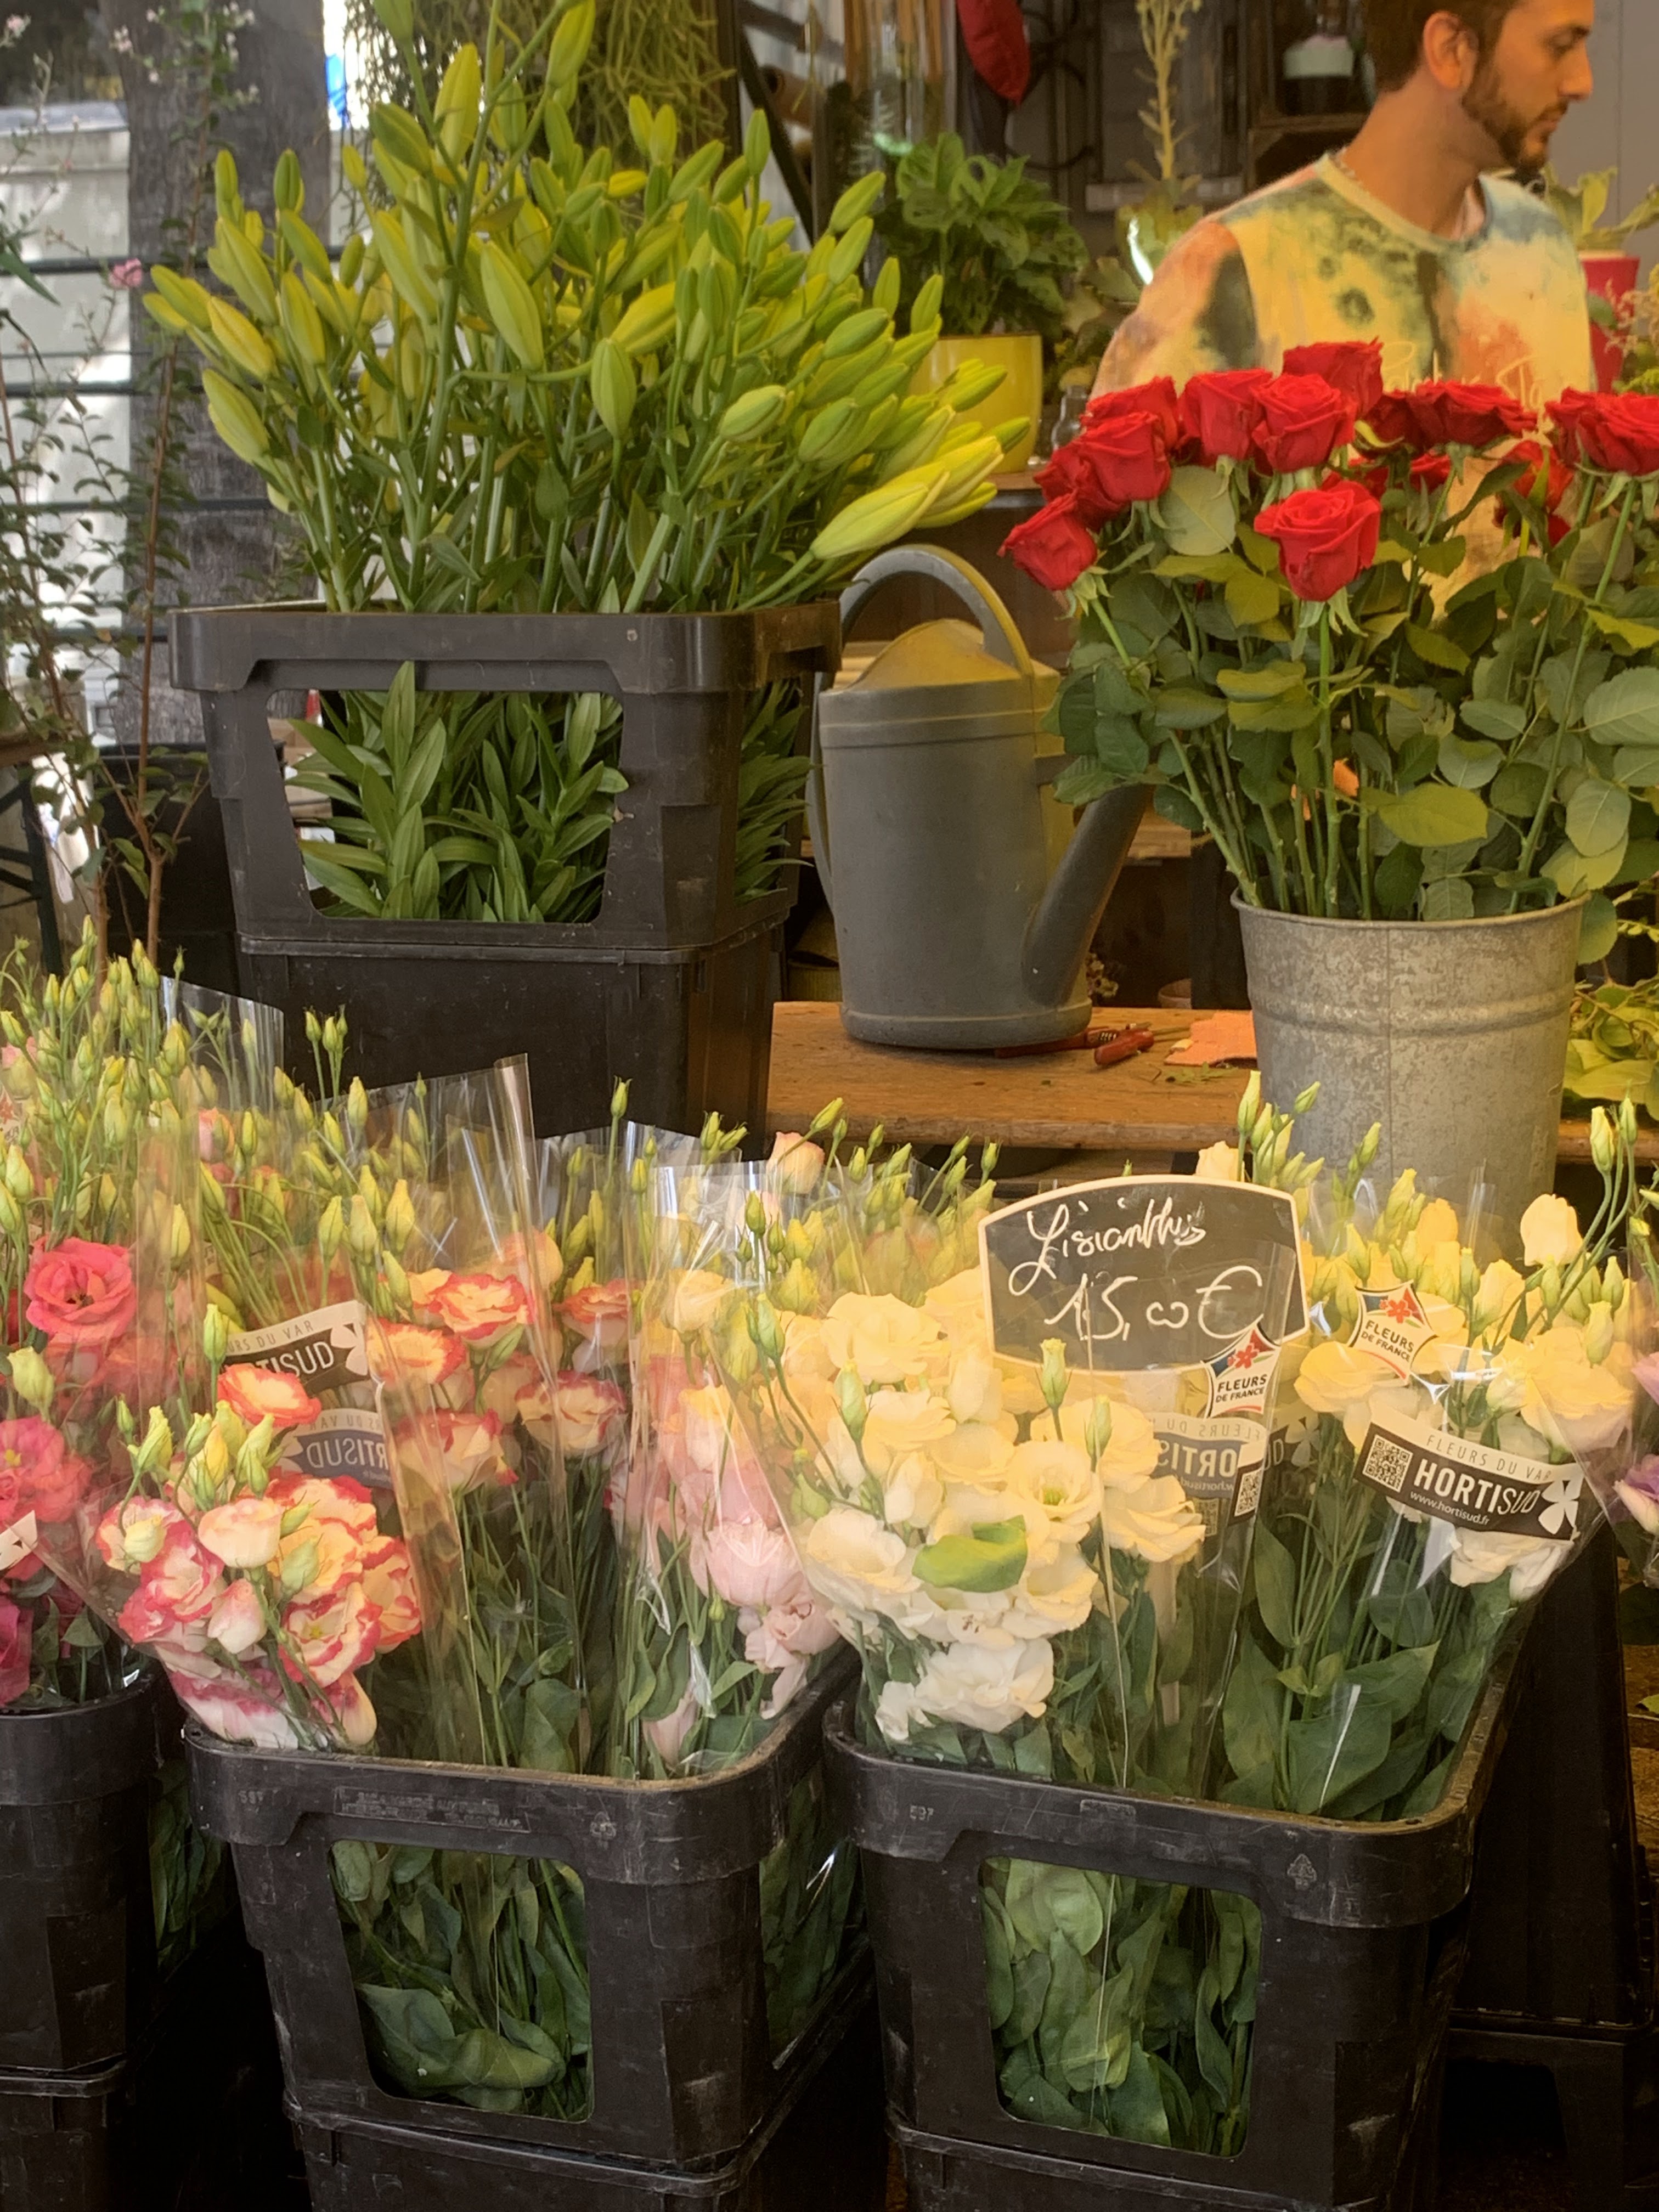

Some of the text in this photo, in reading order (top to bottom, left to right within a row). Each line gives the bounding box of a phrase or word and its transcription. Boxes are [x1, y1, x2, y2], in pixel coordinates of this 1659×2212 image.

[256, 1333, 276, 1347] DU
[283, 1319, 314, 1339] VAR
[1361, 1331, 1410, 1363] DE FRANCE
[1365, 1319, 1415, 1353] FLEURS
[1215, 1386, 1265, 1403] DE FRANCE
[1217, 1373, 1268, 1393] FLEURS
[1426, 1434, 1553, 1481] FLEURS DU VAR
[1413, 1458, 1541, 1516] HORTISUD
[1410, 1491, 1491, 1526] www.hortisud.fr
